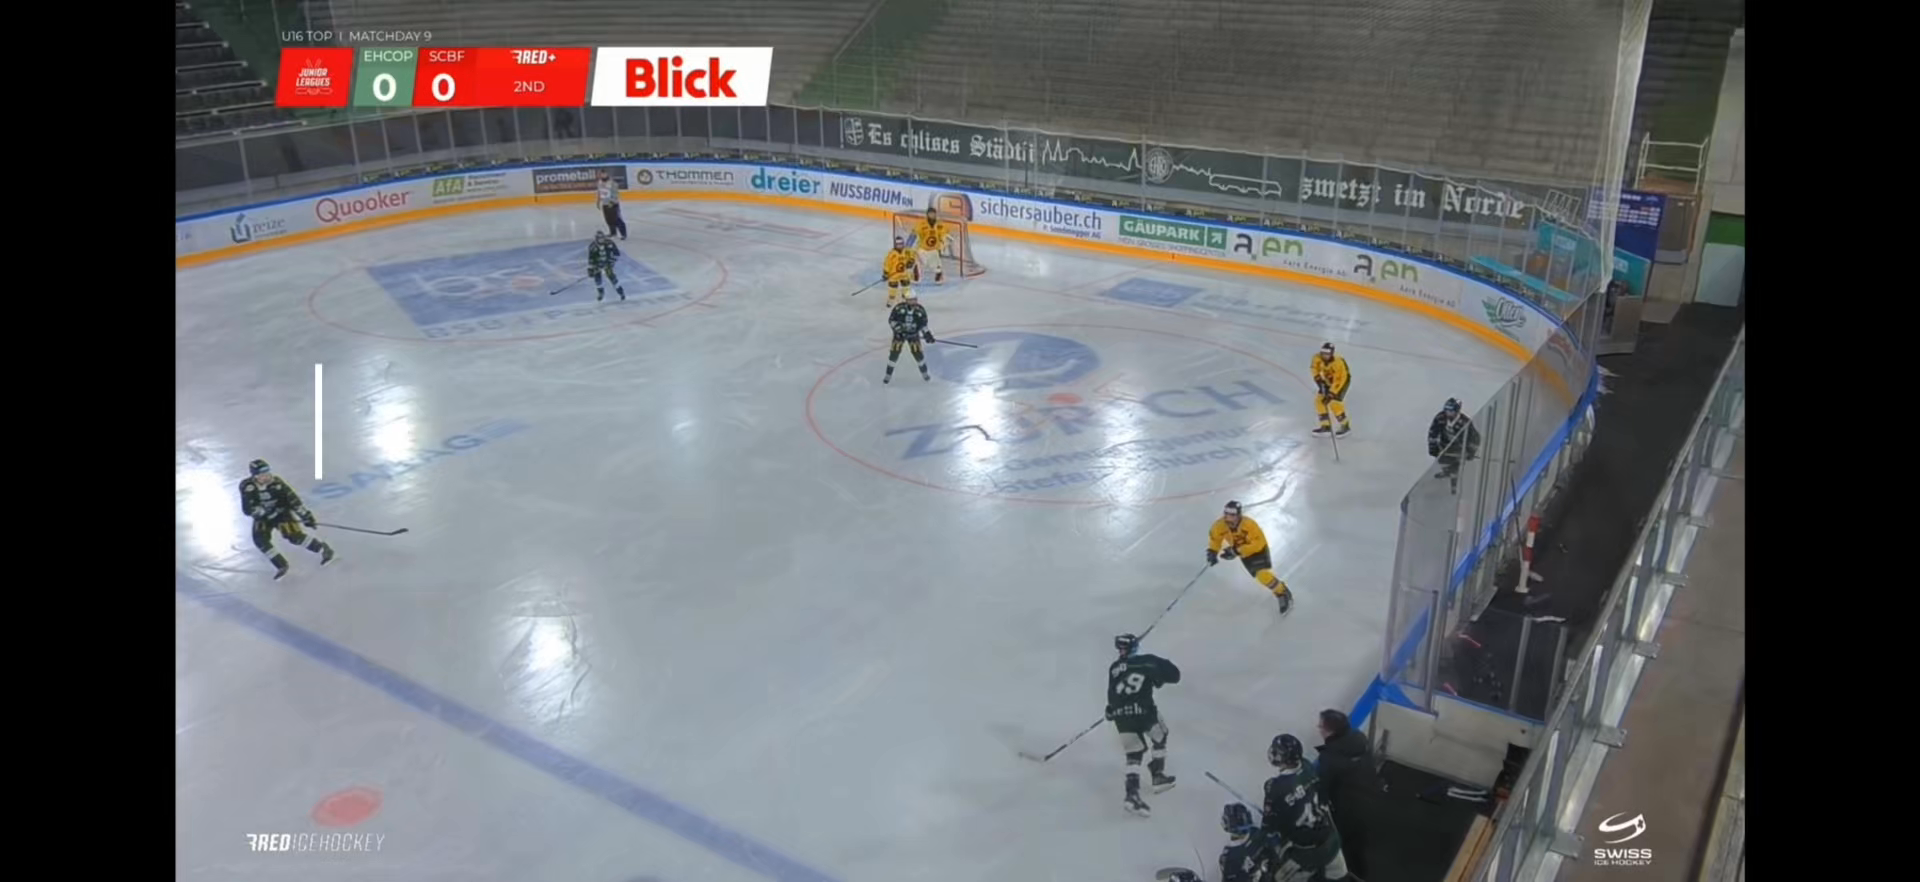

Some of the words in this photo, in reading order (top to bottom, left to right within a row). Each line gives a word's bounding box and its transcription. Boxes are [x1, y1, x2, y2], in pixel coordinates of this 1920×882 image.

[536, 169, 596, 185] prometall
[655, 169, 734, 182] THOMMEN
[867, 122, 893, 146] Es
[1393, 183, 1426, 209] im
[751, 167, 821, 194] dreier
[829, 181, 901, 206] NUSSBAUM
[315, 190, 411, 223] Quooker
[980, 198, 1101, 231] sichersauber.ch
[1123, 220, 1200, 242] GÄUPARK
[884, 379, 1286, 462] ZRCH
